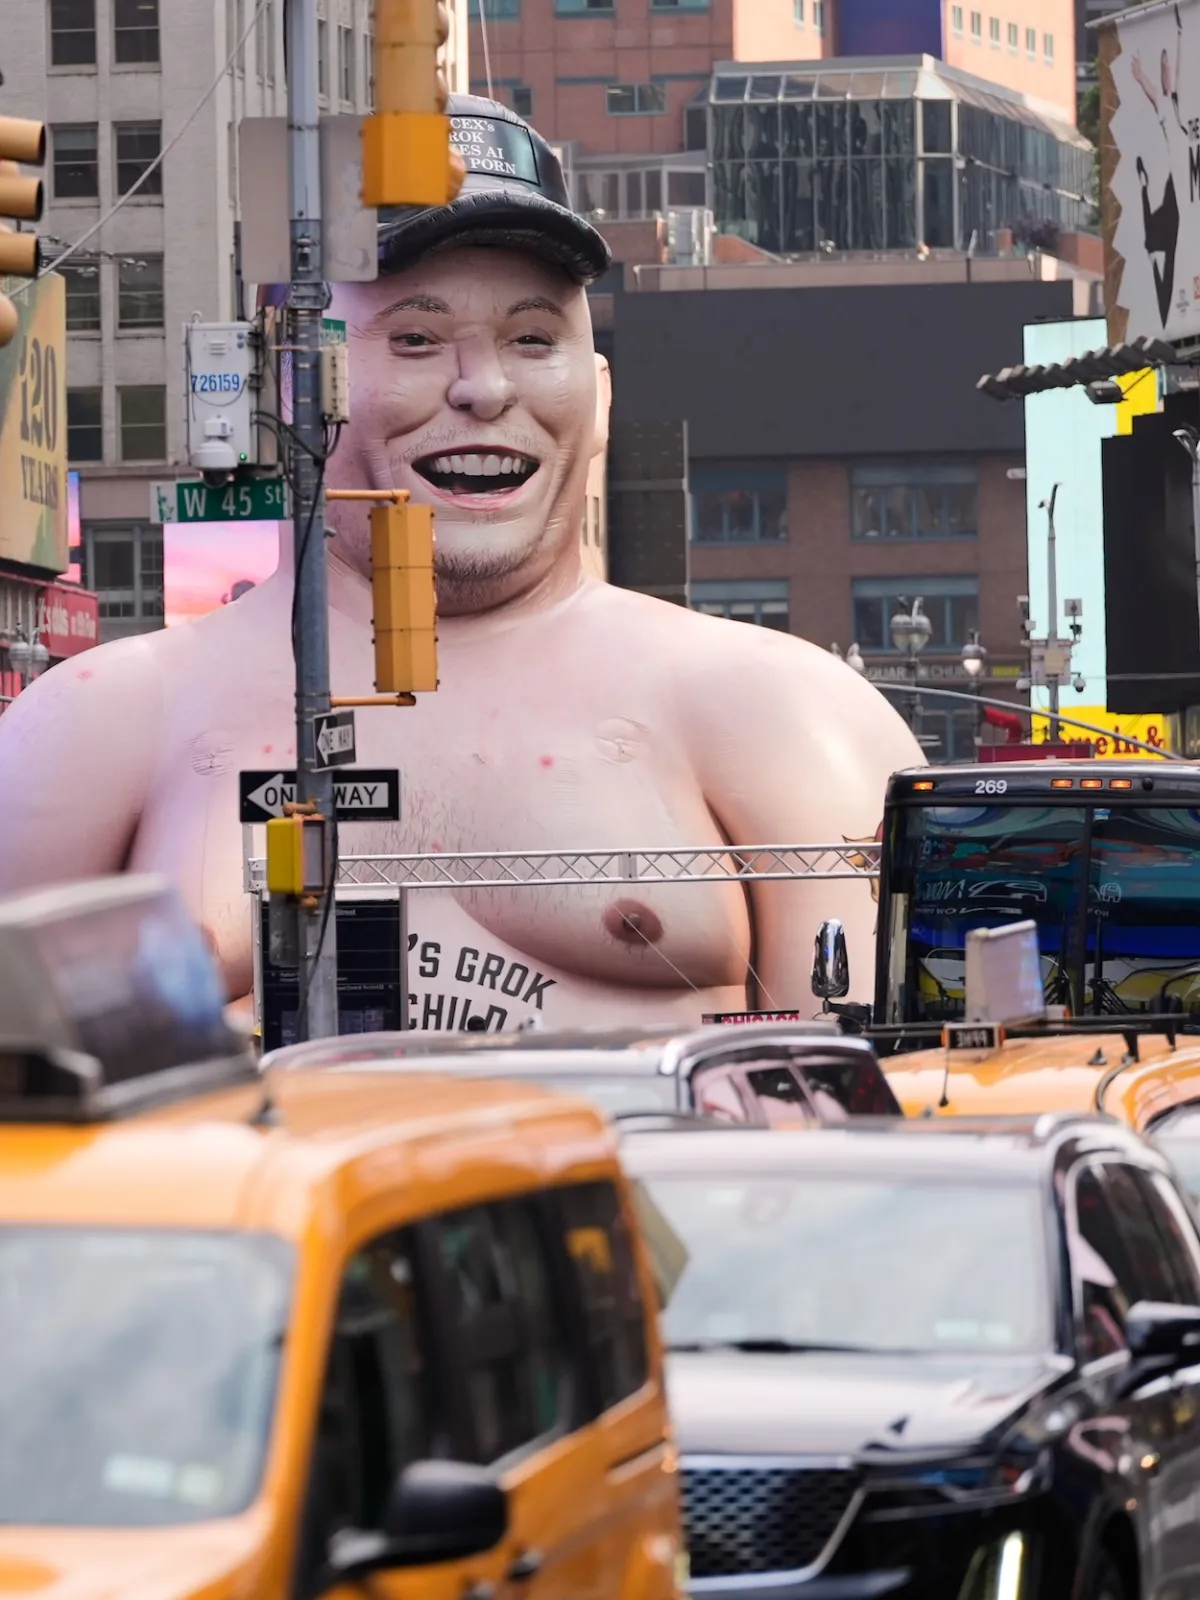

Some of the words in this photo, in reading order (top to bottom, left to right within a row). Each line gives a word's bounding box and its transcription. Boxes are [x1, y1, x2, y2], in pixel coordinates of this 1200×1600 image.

[449, 118, 495, 132] CEX's
[448, 131, 485, 143] ROK
[486, 146, 504, 159] AI
[469, 158, 517, 175] PORN
[191, 374, 240, 392] 726159
[20, 334, 58, 453] 120
[20, 454, 59, 510] YEARS
[183, 488, 207, 518] W
[221, 486, 252, 517] 45
[264, 484, 282, 505] St
[321, 730, 334, 752] ONE
[338, 728, 351, 749] WAY
[264, 786, 293, 806] ON
[333, 785, 378, 806] WAY
[974, 779, 1008, 794] 269
[455, 946, 558, 1011] GROK
